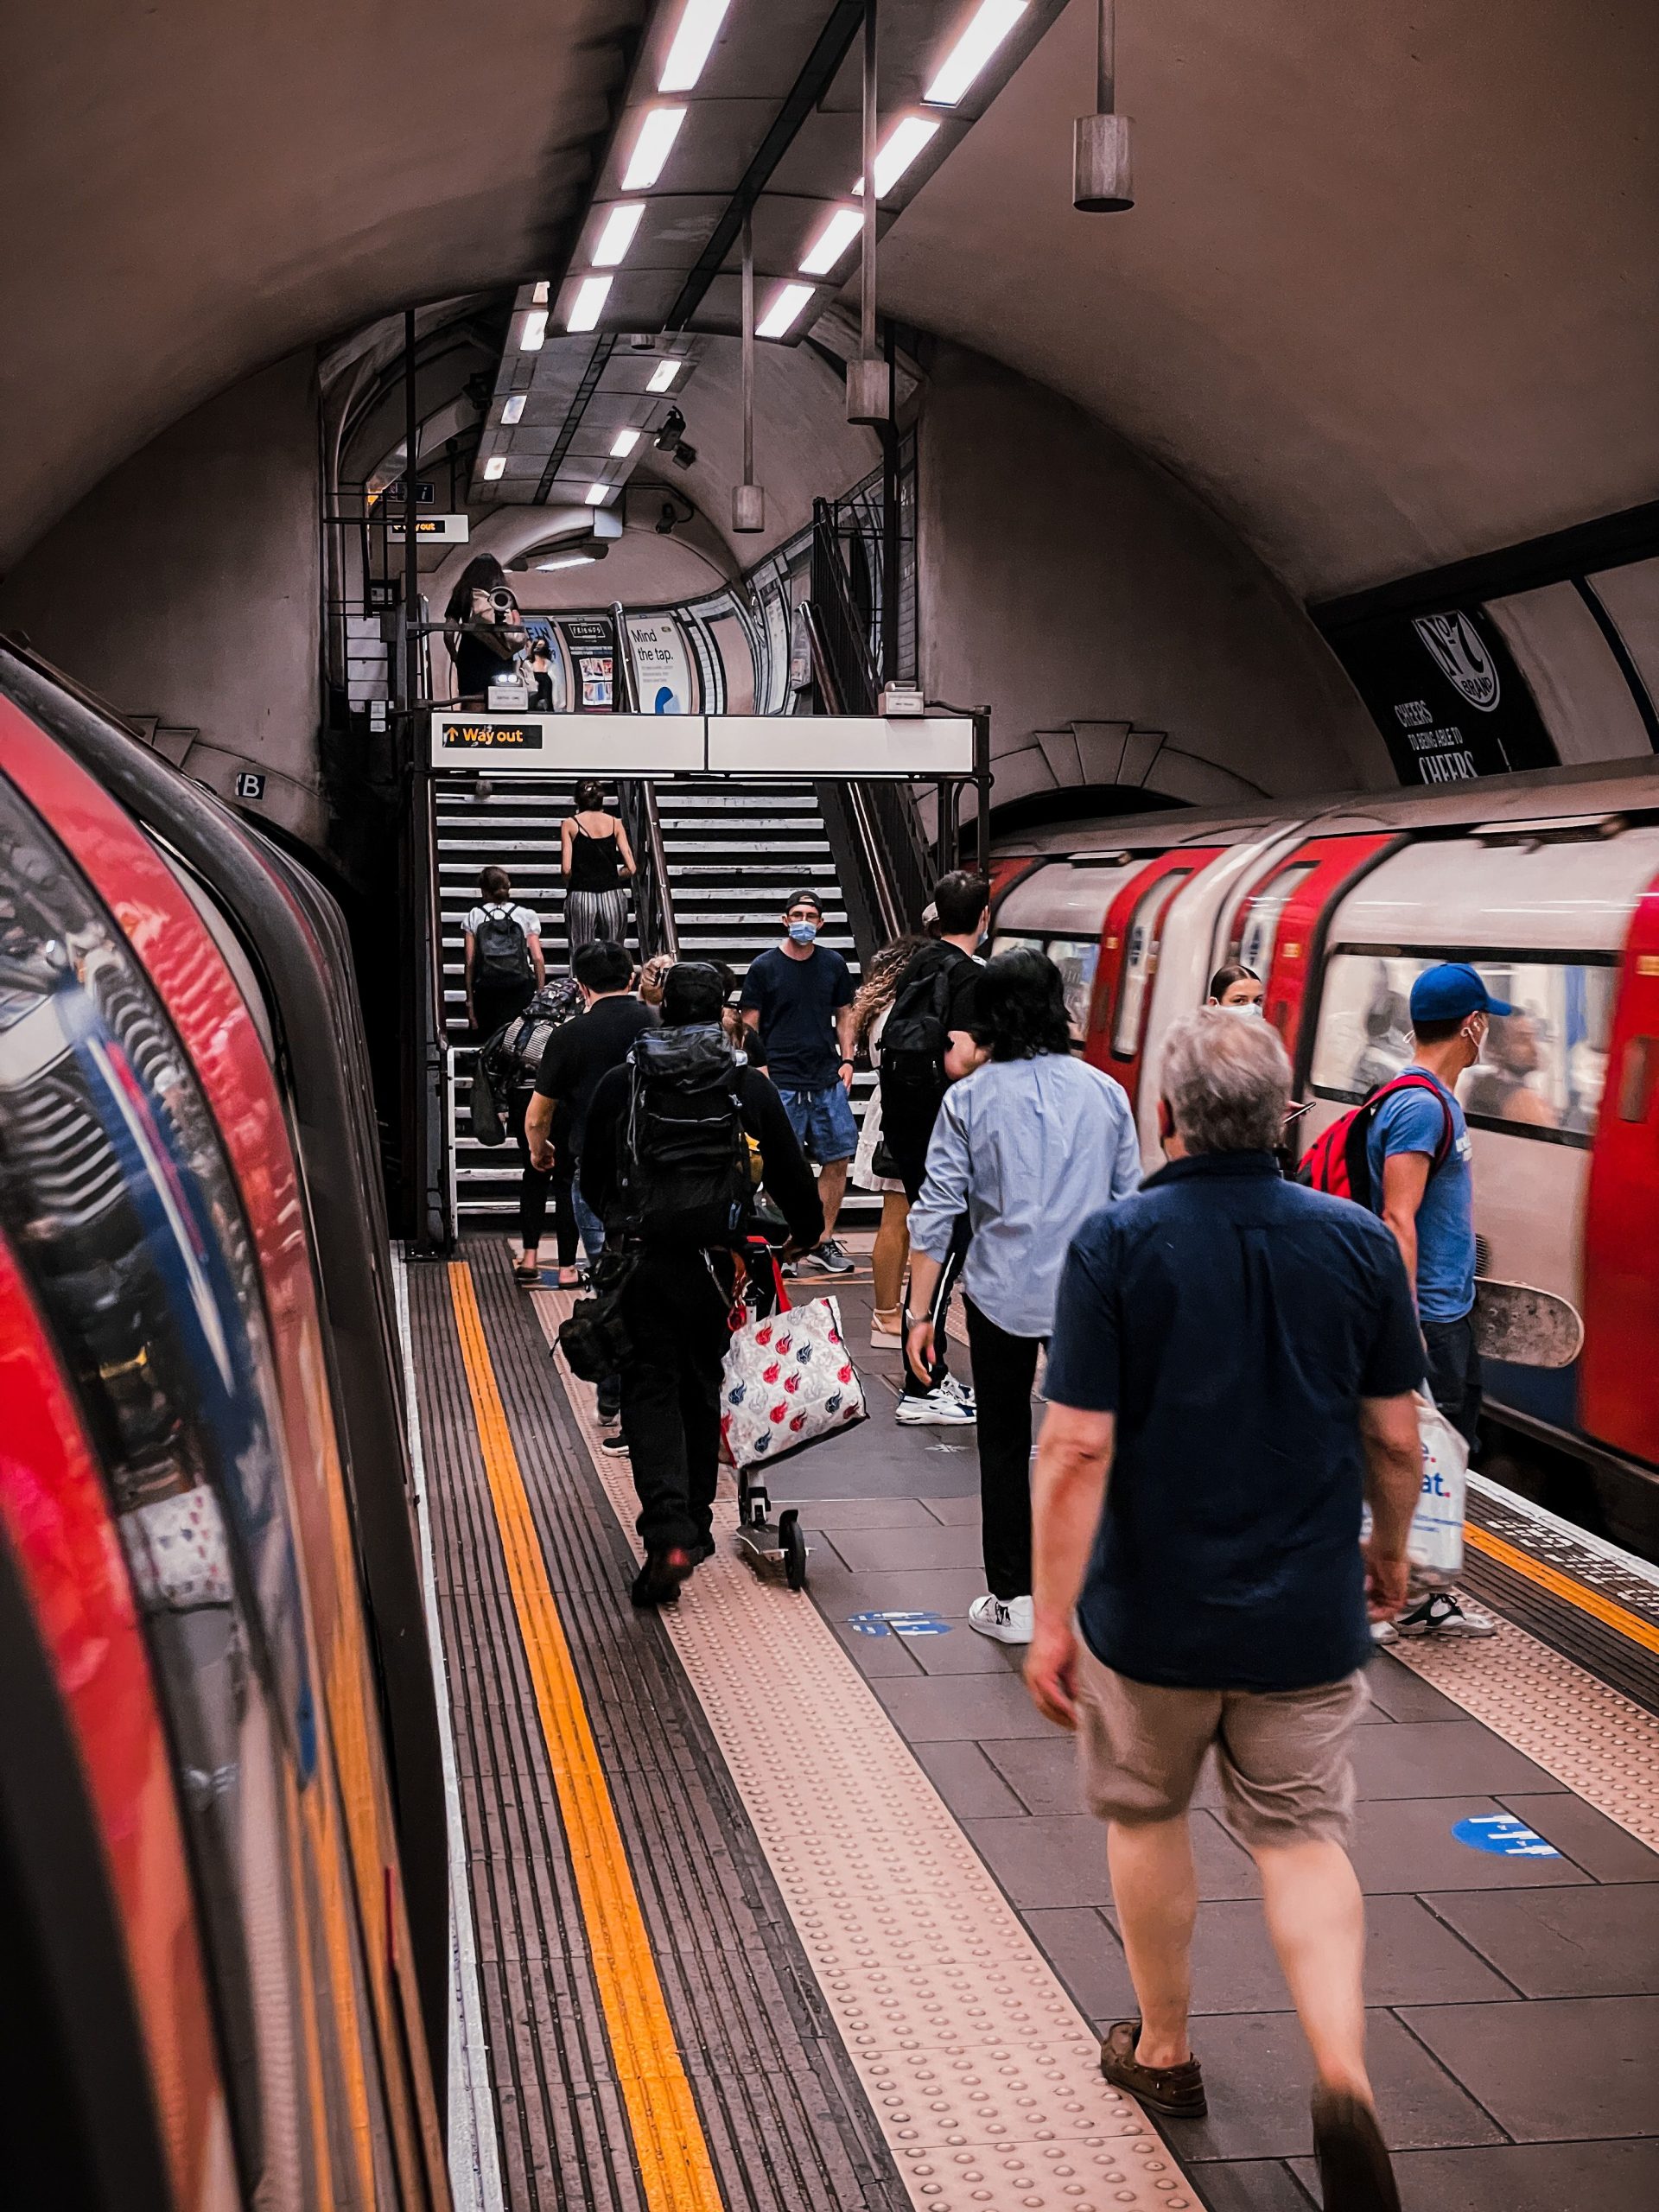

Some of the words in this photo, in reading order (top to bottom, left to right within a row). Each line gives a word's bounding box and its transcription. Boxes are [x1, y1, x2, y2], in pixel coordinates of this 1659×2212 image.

[631, 628, 657, 642] Mind
[638, 647, 653, 660] the
[655, 648, 673, 664] tap.
[1460, 677, 1493, 699] BRAND
[1394, 700, 1433, 727] CHEERS
[462, 728, 494, 746] Way
[496, 730, 524, 742] out
[1407, 734, 1420, 751] TO
[1416, 731, 1438, 750] BEING
[1435, 728, 1455, 747] ABLE
[1451, 727, 1463, 744] TO
[242, 774, 260, 798] B
